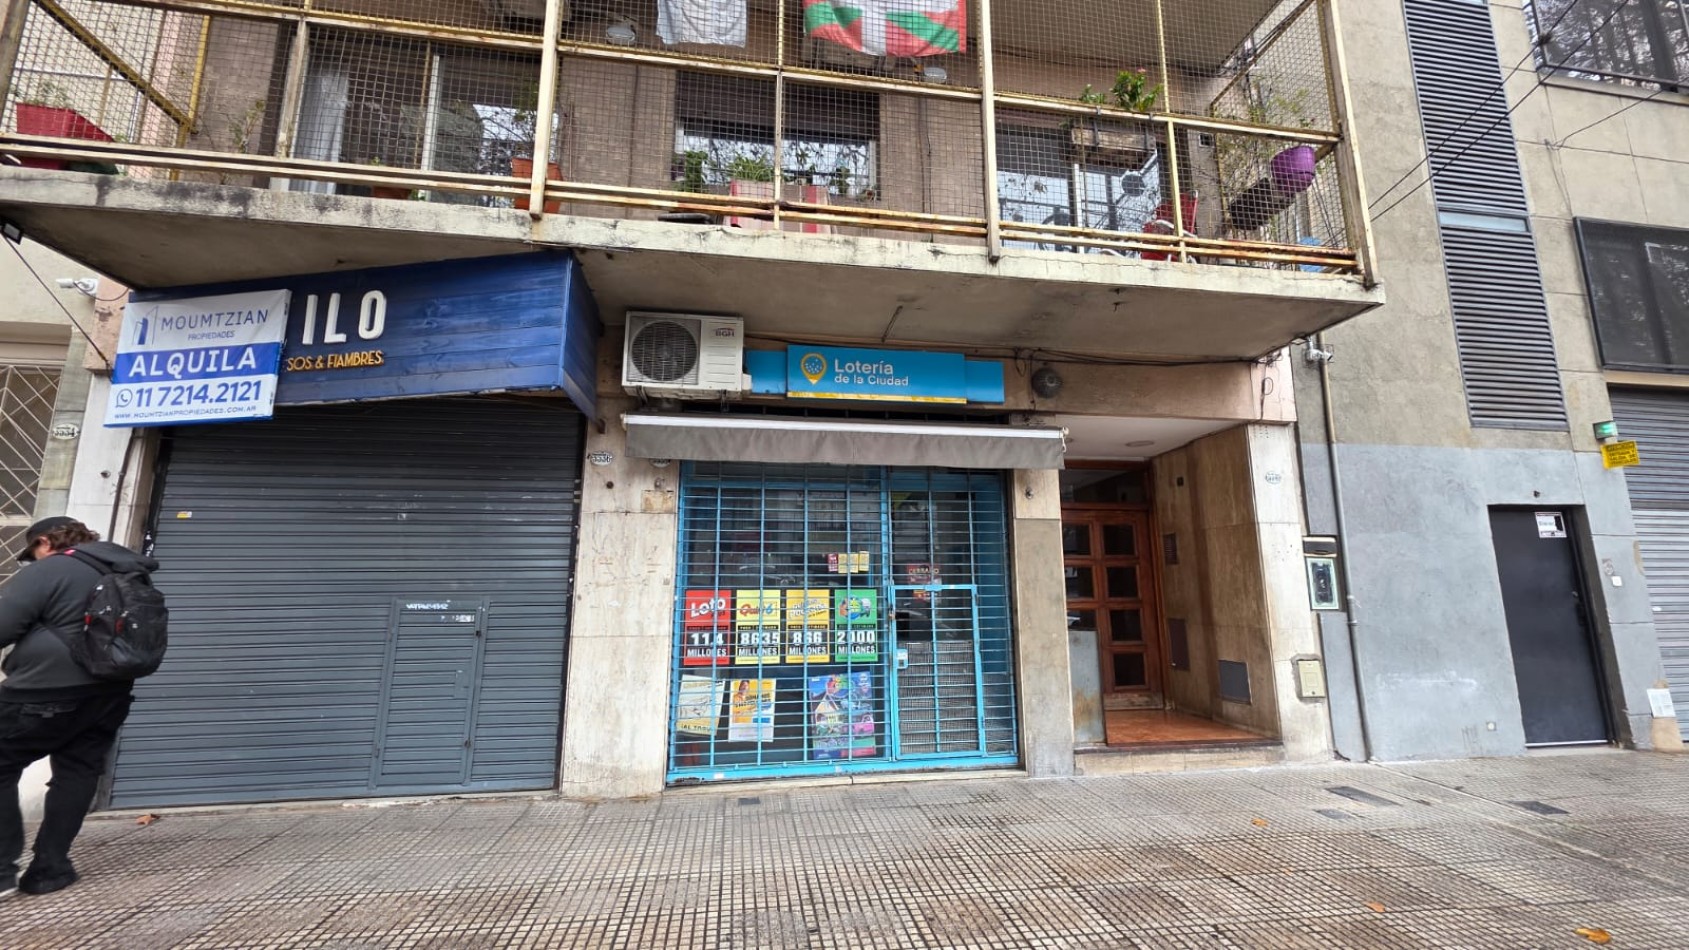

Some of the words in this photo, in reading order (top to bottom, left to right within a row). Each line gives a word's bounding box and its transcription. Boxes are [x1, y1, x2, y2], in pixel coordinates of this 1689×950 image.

[160, 309, 269, 331] MOUMTZIAN
[187, 330, 235, 341] PROPIEDADES
[128, 347, 257, 379] ALQUILA
[315, 355, 324, 368] &
[327, 350, 385, 368] FIAMBRES
[834, 360, 894, 375] Lotería
[834, 374, 849, 384] de
[854, 374, 864, 384] la
[867, 375, 908, 387] Ciudad
[136, 387, 152, 407] 11
[158, 380, 261, 407] 7214.2121
[690, 598, 726, 618] Loto
[687, 648, 727, 657] MILLOES
[738, 648, 778, 656] MILLNES
[789, 646, 827, 655] MILONES
[838, 645, 876, 654] MILONES
